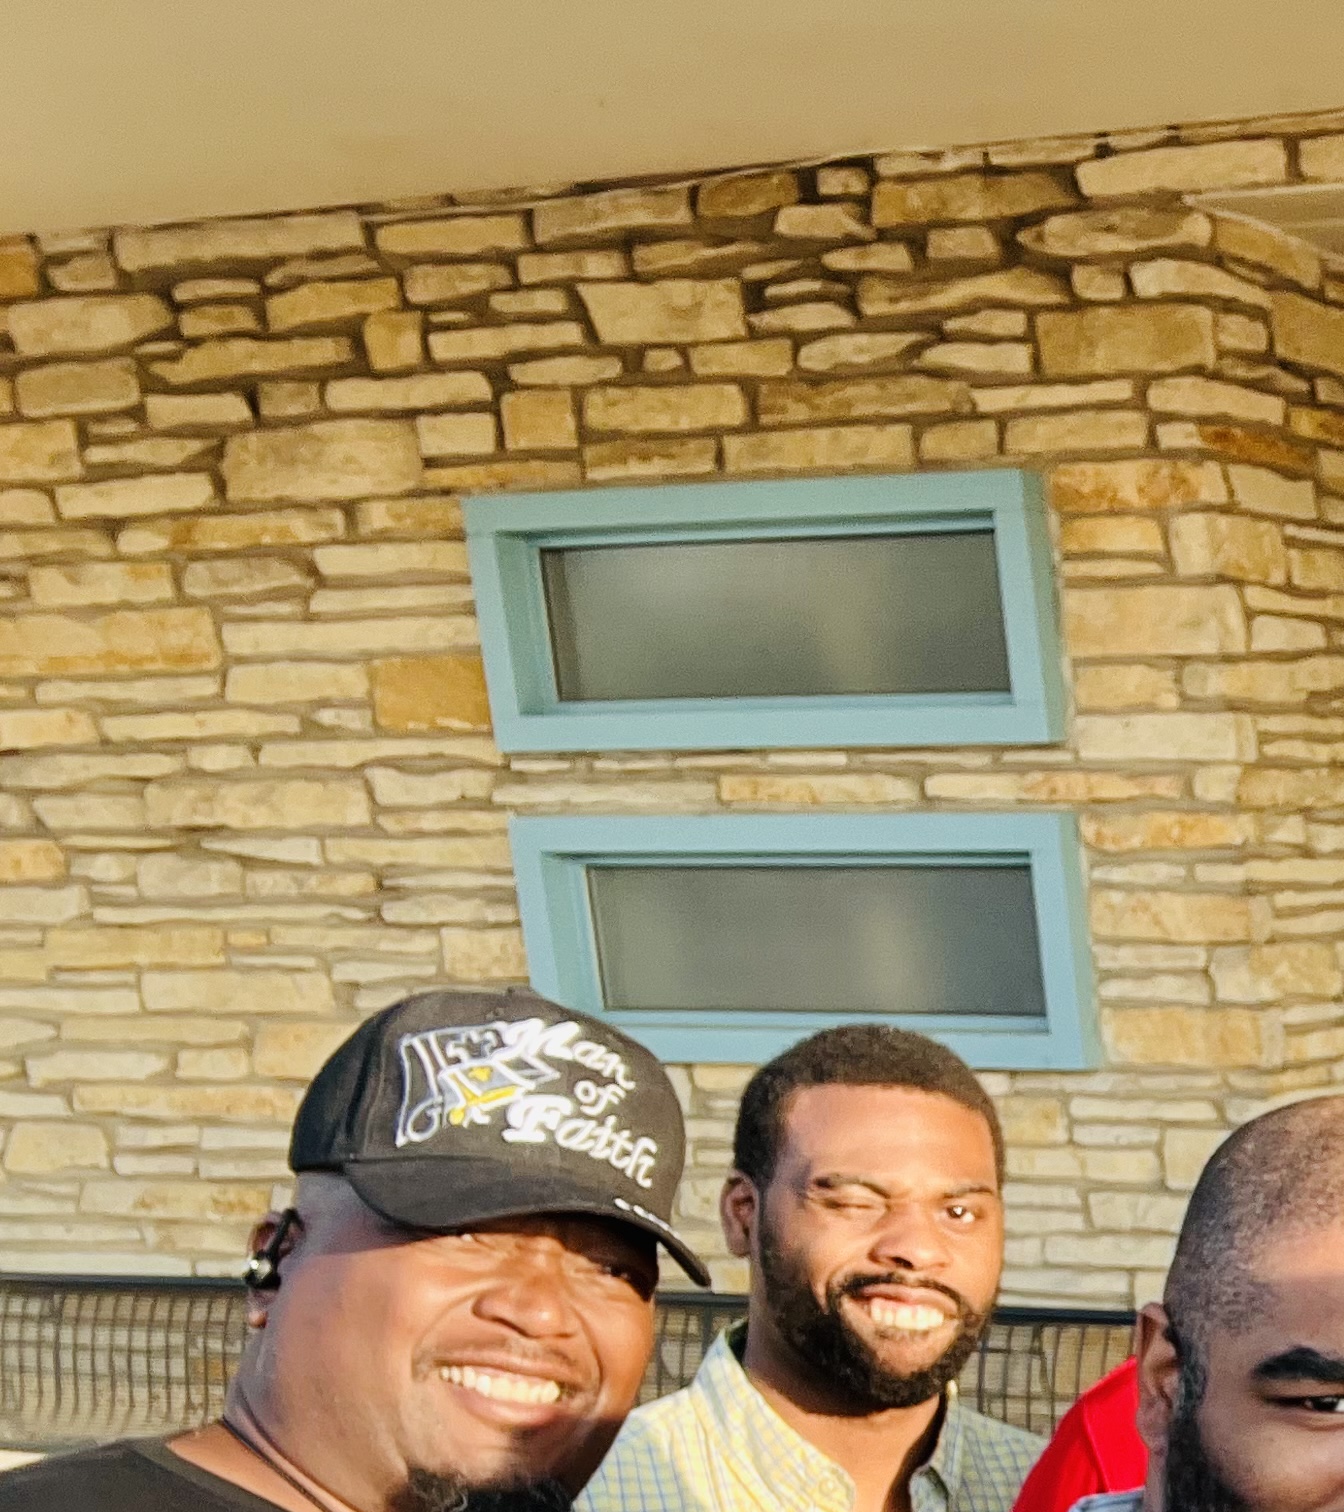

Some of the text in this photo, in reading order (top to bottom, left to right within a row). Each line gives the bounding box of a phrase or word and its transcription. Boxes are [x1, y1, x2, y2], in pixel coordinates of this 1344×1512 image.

[498, 1018, 638, 1092] Man
[573, 1079, 623, 1121] of
[502, 1093, 659, 1188] Faith
